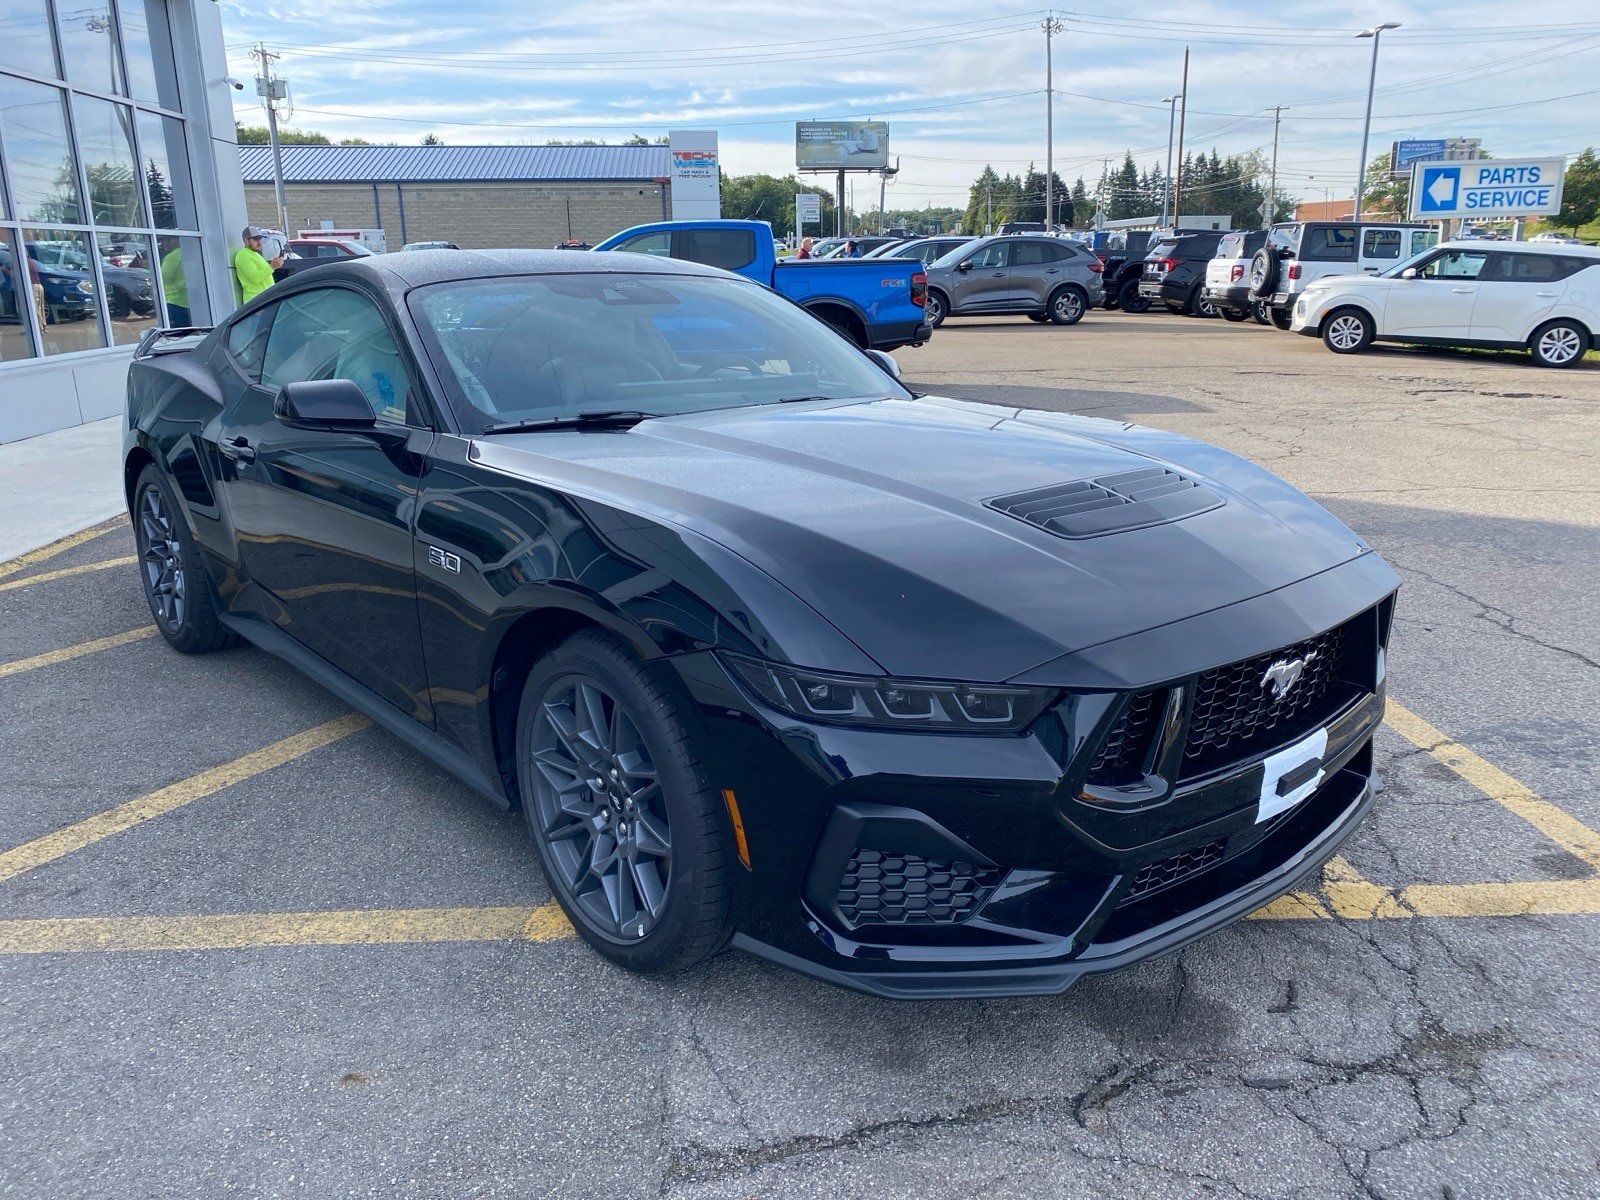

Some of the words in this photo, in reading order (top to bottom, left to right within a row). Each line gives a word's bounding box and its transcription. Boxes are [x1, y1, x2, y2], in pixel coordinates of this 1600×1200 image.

[672, 151, 716, 160] TECH
[672, 159, 717, 168] WASH
[1479, 166, 1541, 184] PARTS
[1465, 189, 1550, 208] SERVICE
